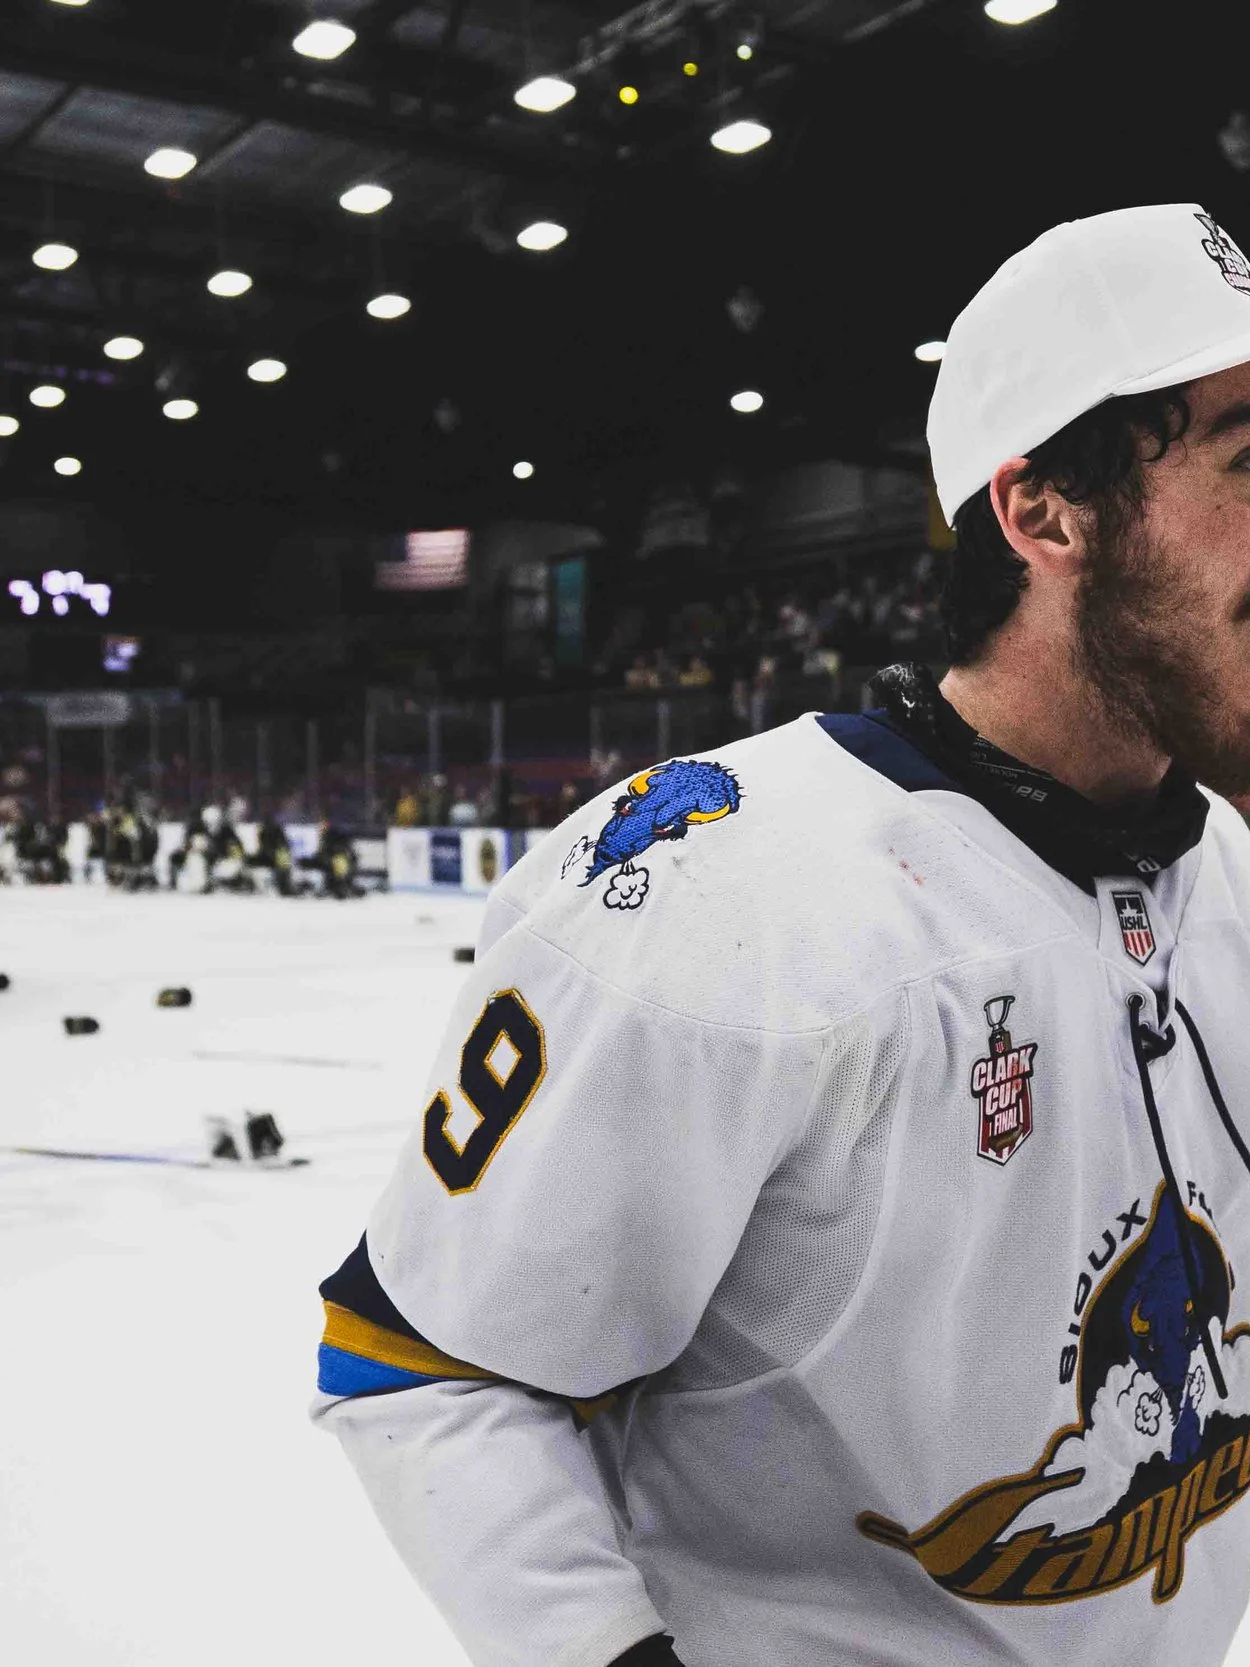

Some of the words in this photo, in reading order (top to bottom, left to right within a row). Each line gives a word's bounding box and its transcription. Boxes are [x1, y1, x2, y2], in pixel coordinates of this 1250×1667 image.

[1120, 914, 1148, 931] USHL
[972, 1046, 1034, 1092] CLARK
[422, 986, 548, 1196] 9
[985, 1078, 1023, 1116] CUP
[993, 1106, 1018, 1136] FINAL
[1059, 1197, 1149, 1385] SIOUX
